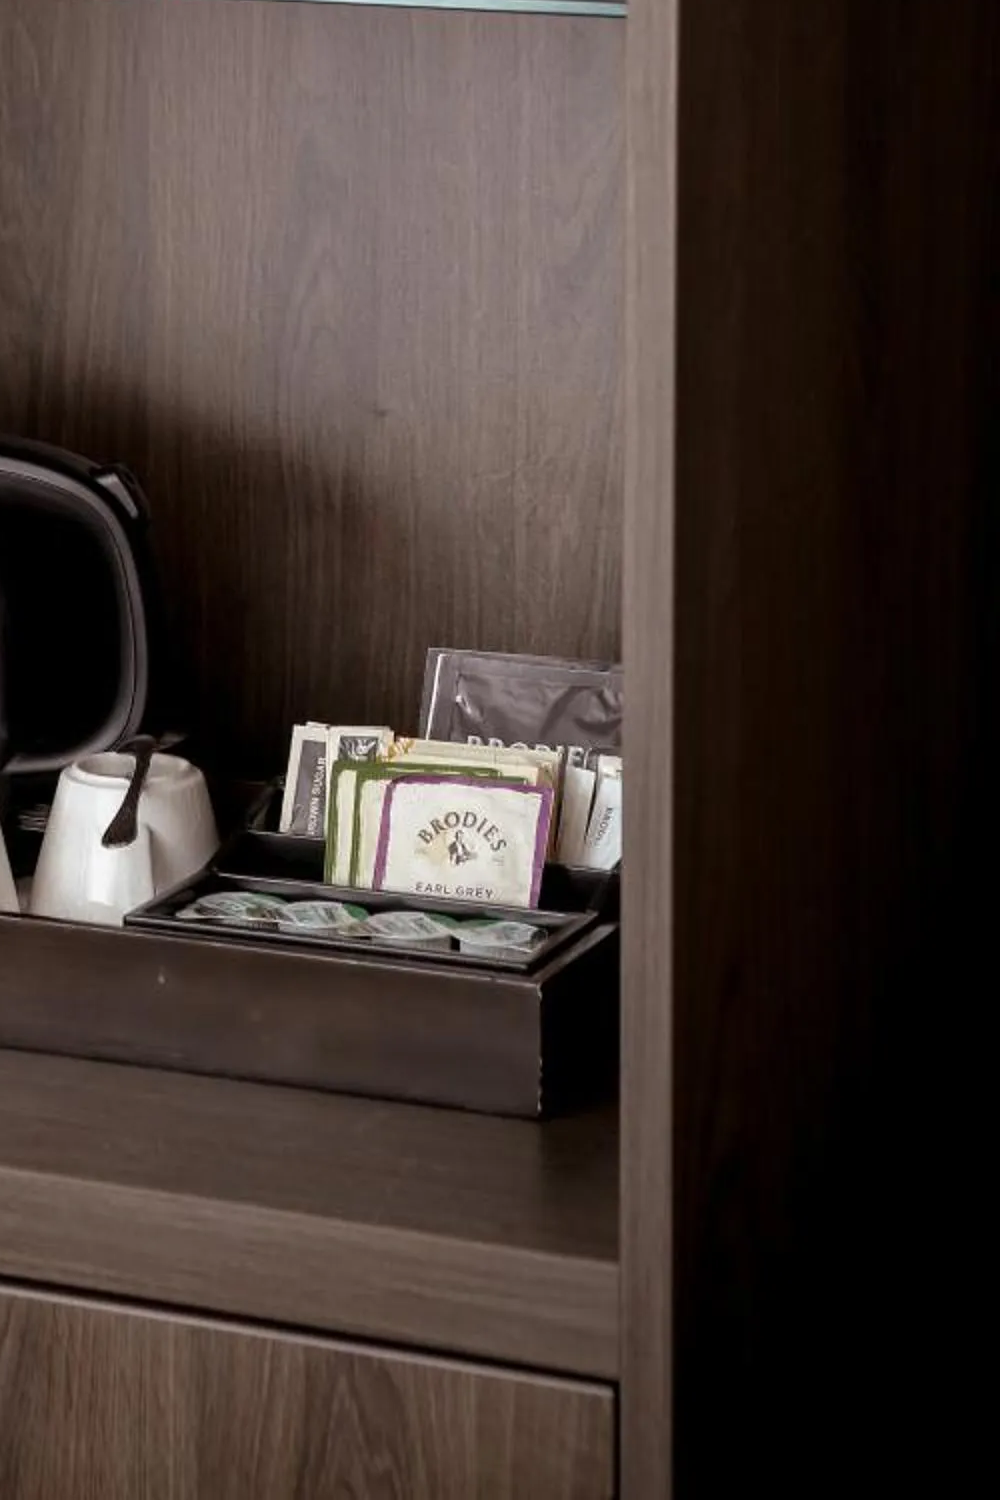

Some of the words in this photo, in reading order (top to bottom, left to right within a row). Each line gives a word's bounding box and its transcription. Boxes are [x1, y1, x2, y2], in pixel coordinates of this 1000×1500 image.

[417, 811, 507, 852] BRODIES
[415, 882, 451, 895] EARL
[456, 885, 494, 899] GREY
